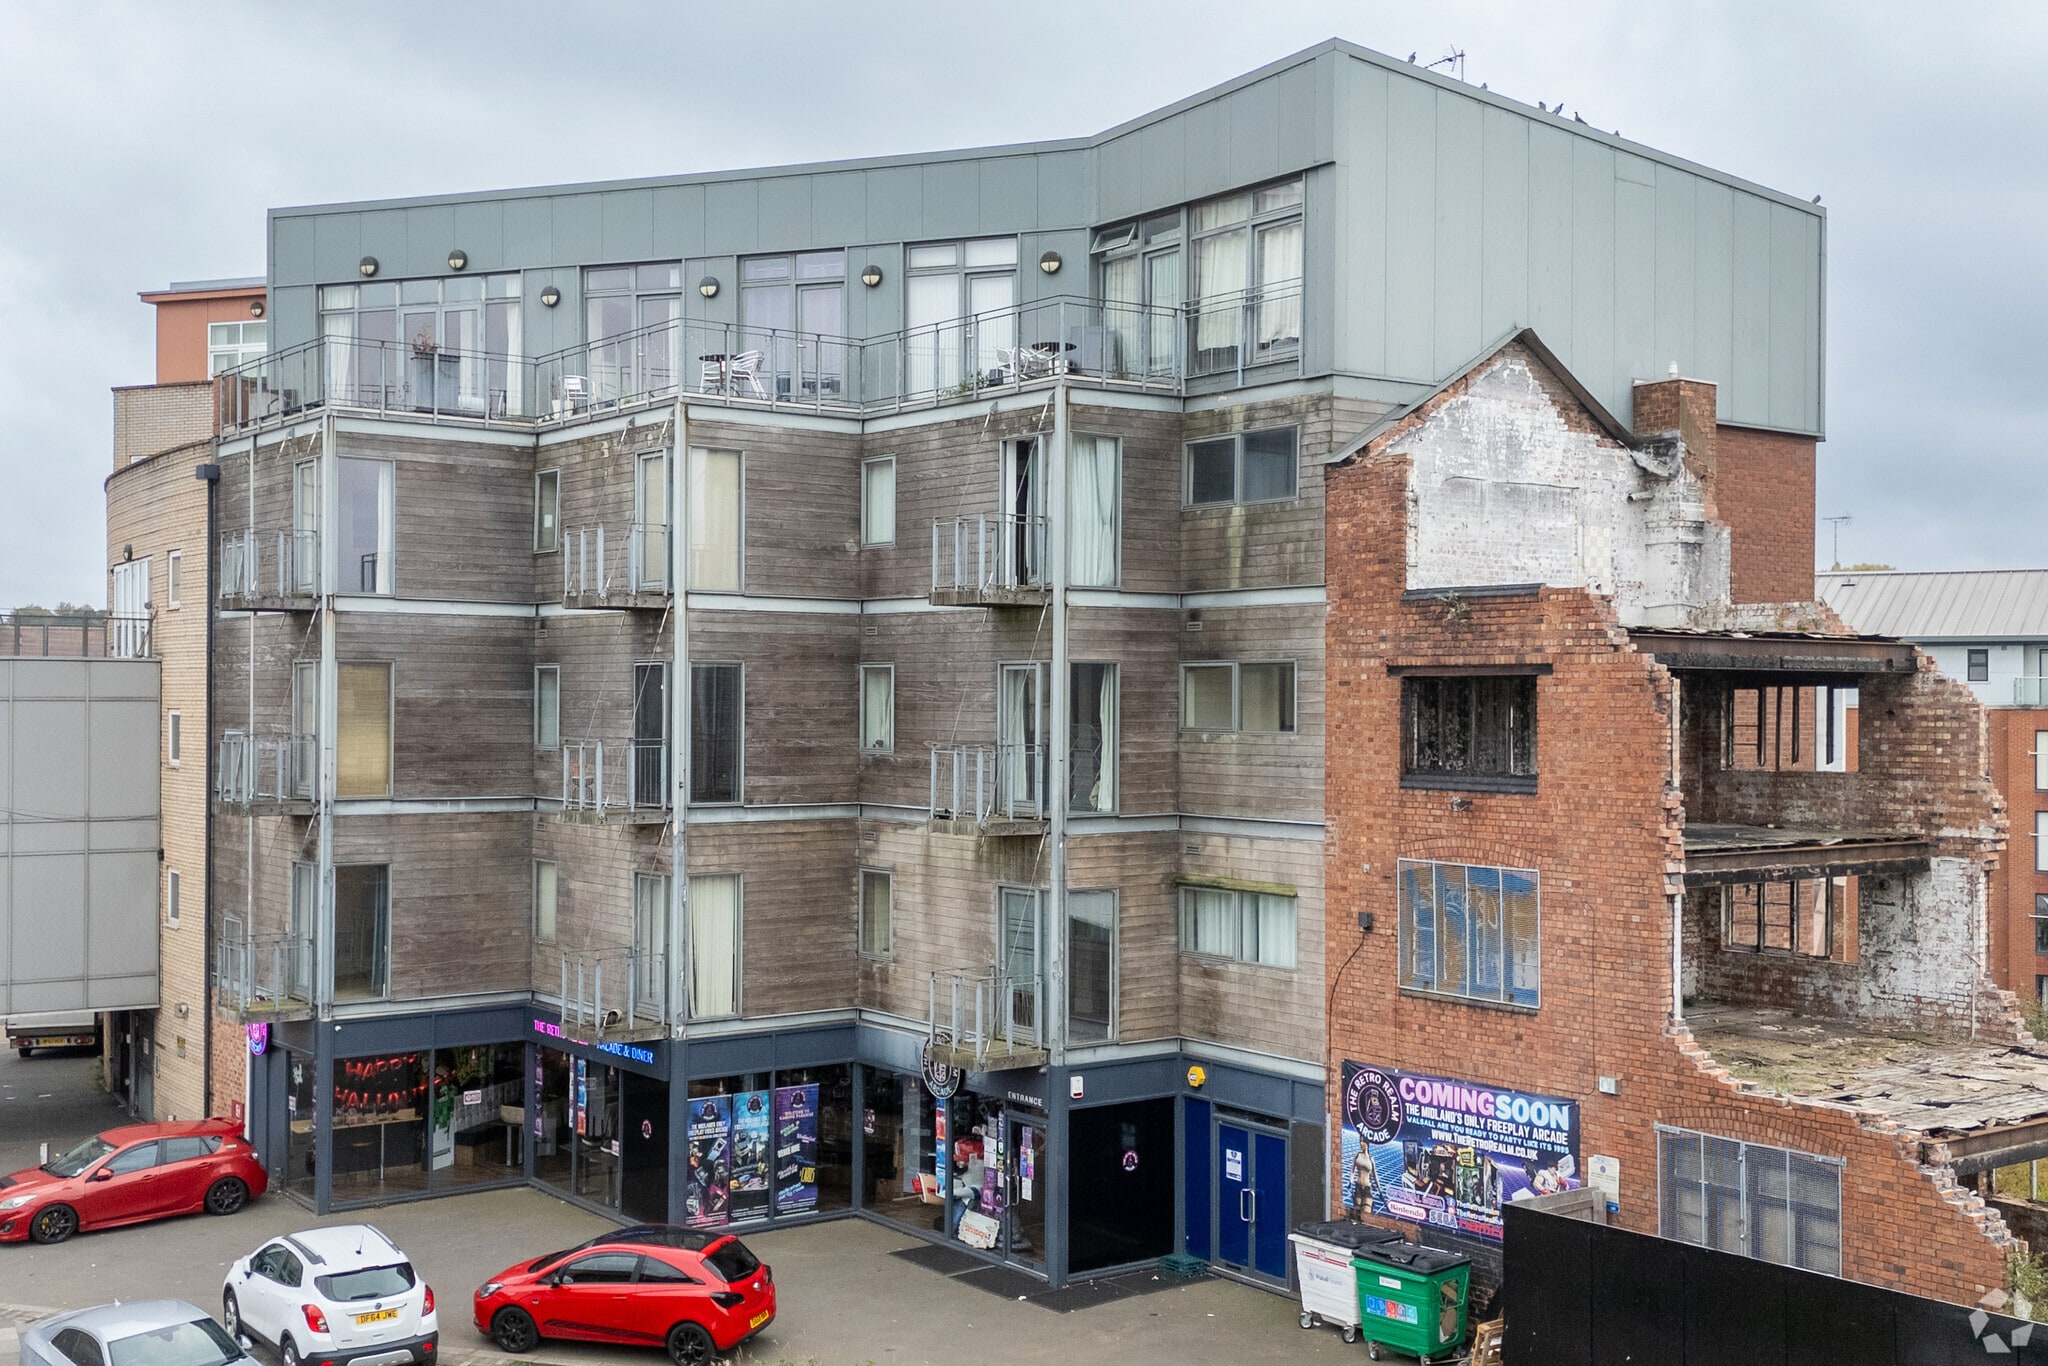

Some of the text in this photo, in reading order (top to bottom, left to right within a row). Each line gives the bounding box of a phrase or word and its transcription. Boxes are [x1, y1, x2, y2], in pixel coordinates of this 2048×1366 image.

[533, 1019, 545, 1033] THE
[631, 1047, 654, 1064] DINER
[1007, 1091, 1043, 1107] ENTRANCE
[1349, 1073, 1399, 1121] THE RETRO REALM
[1400, 1077, 1570, 1131] COMING SOON
[1356, 1122, 1391, 1143] ARCADE
[1405, 1102, 1568, 1145] THE MIDLAND'S ONLY FREEPLAY ARCADE
[1406, 1115, 1436, 1128] WALSALL
[1437, 1122, 1449, 1131] ARE
[1450, 1124, 1464, 1133] YOU
[1465, 1127, 1487, 1138] READY
[1488, 1131, 1499, 1140] TO
[1500, 1134, 1522, 1145] PARTY
[1523, 1138, 1538, 1148] LIKE
[1390, 1203, 1424, 1218] Nintendo
[1429, 1209, 1458, 1229] SEGA
